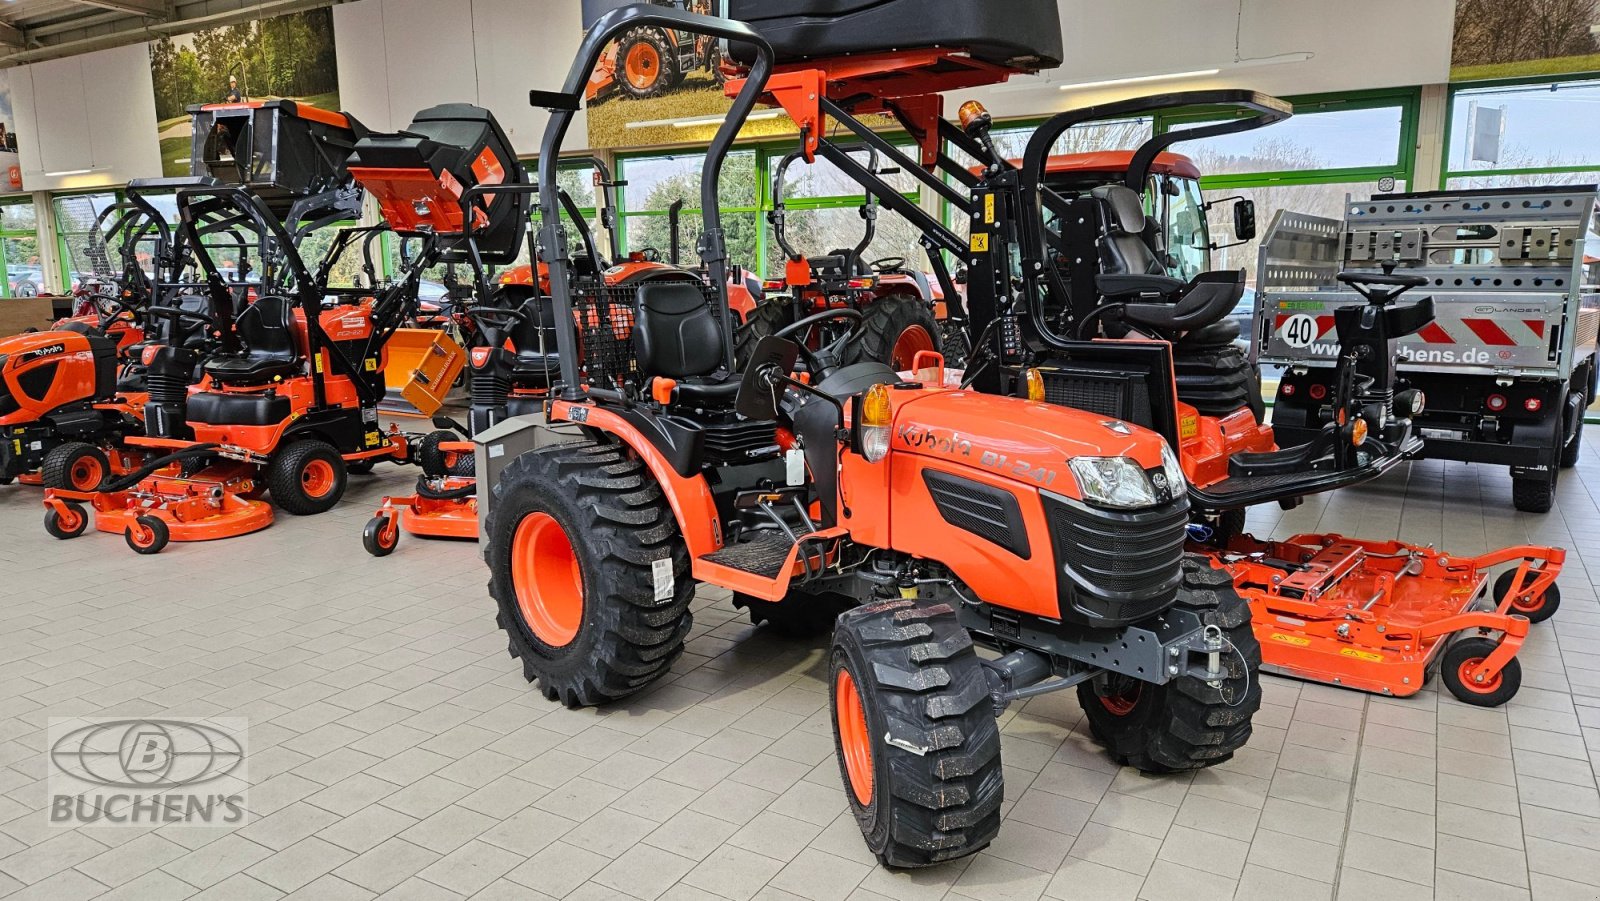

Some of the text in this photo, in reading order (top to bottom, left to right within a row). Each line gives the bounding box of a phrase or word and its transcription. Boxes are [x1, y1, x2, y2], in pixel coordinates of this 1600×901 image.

[1287, 318, 1312, 344] 40
[34, 345, 63, 356] Kubota
[898, 424, 1057, 486] Kubota B1-241
